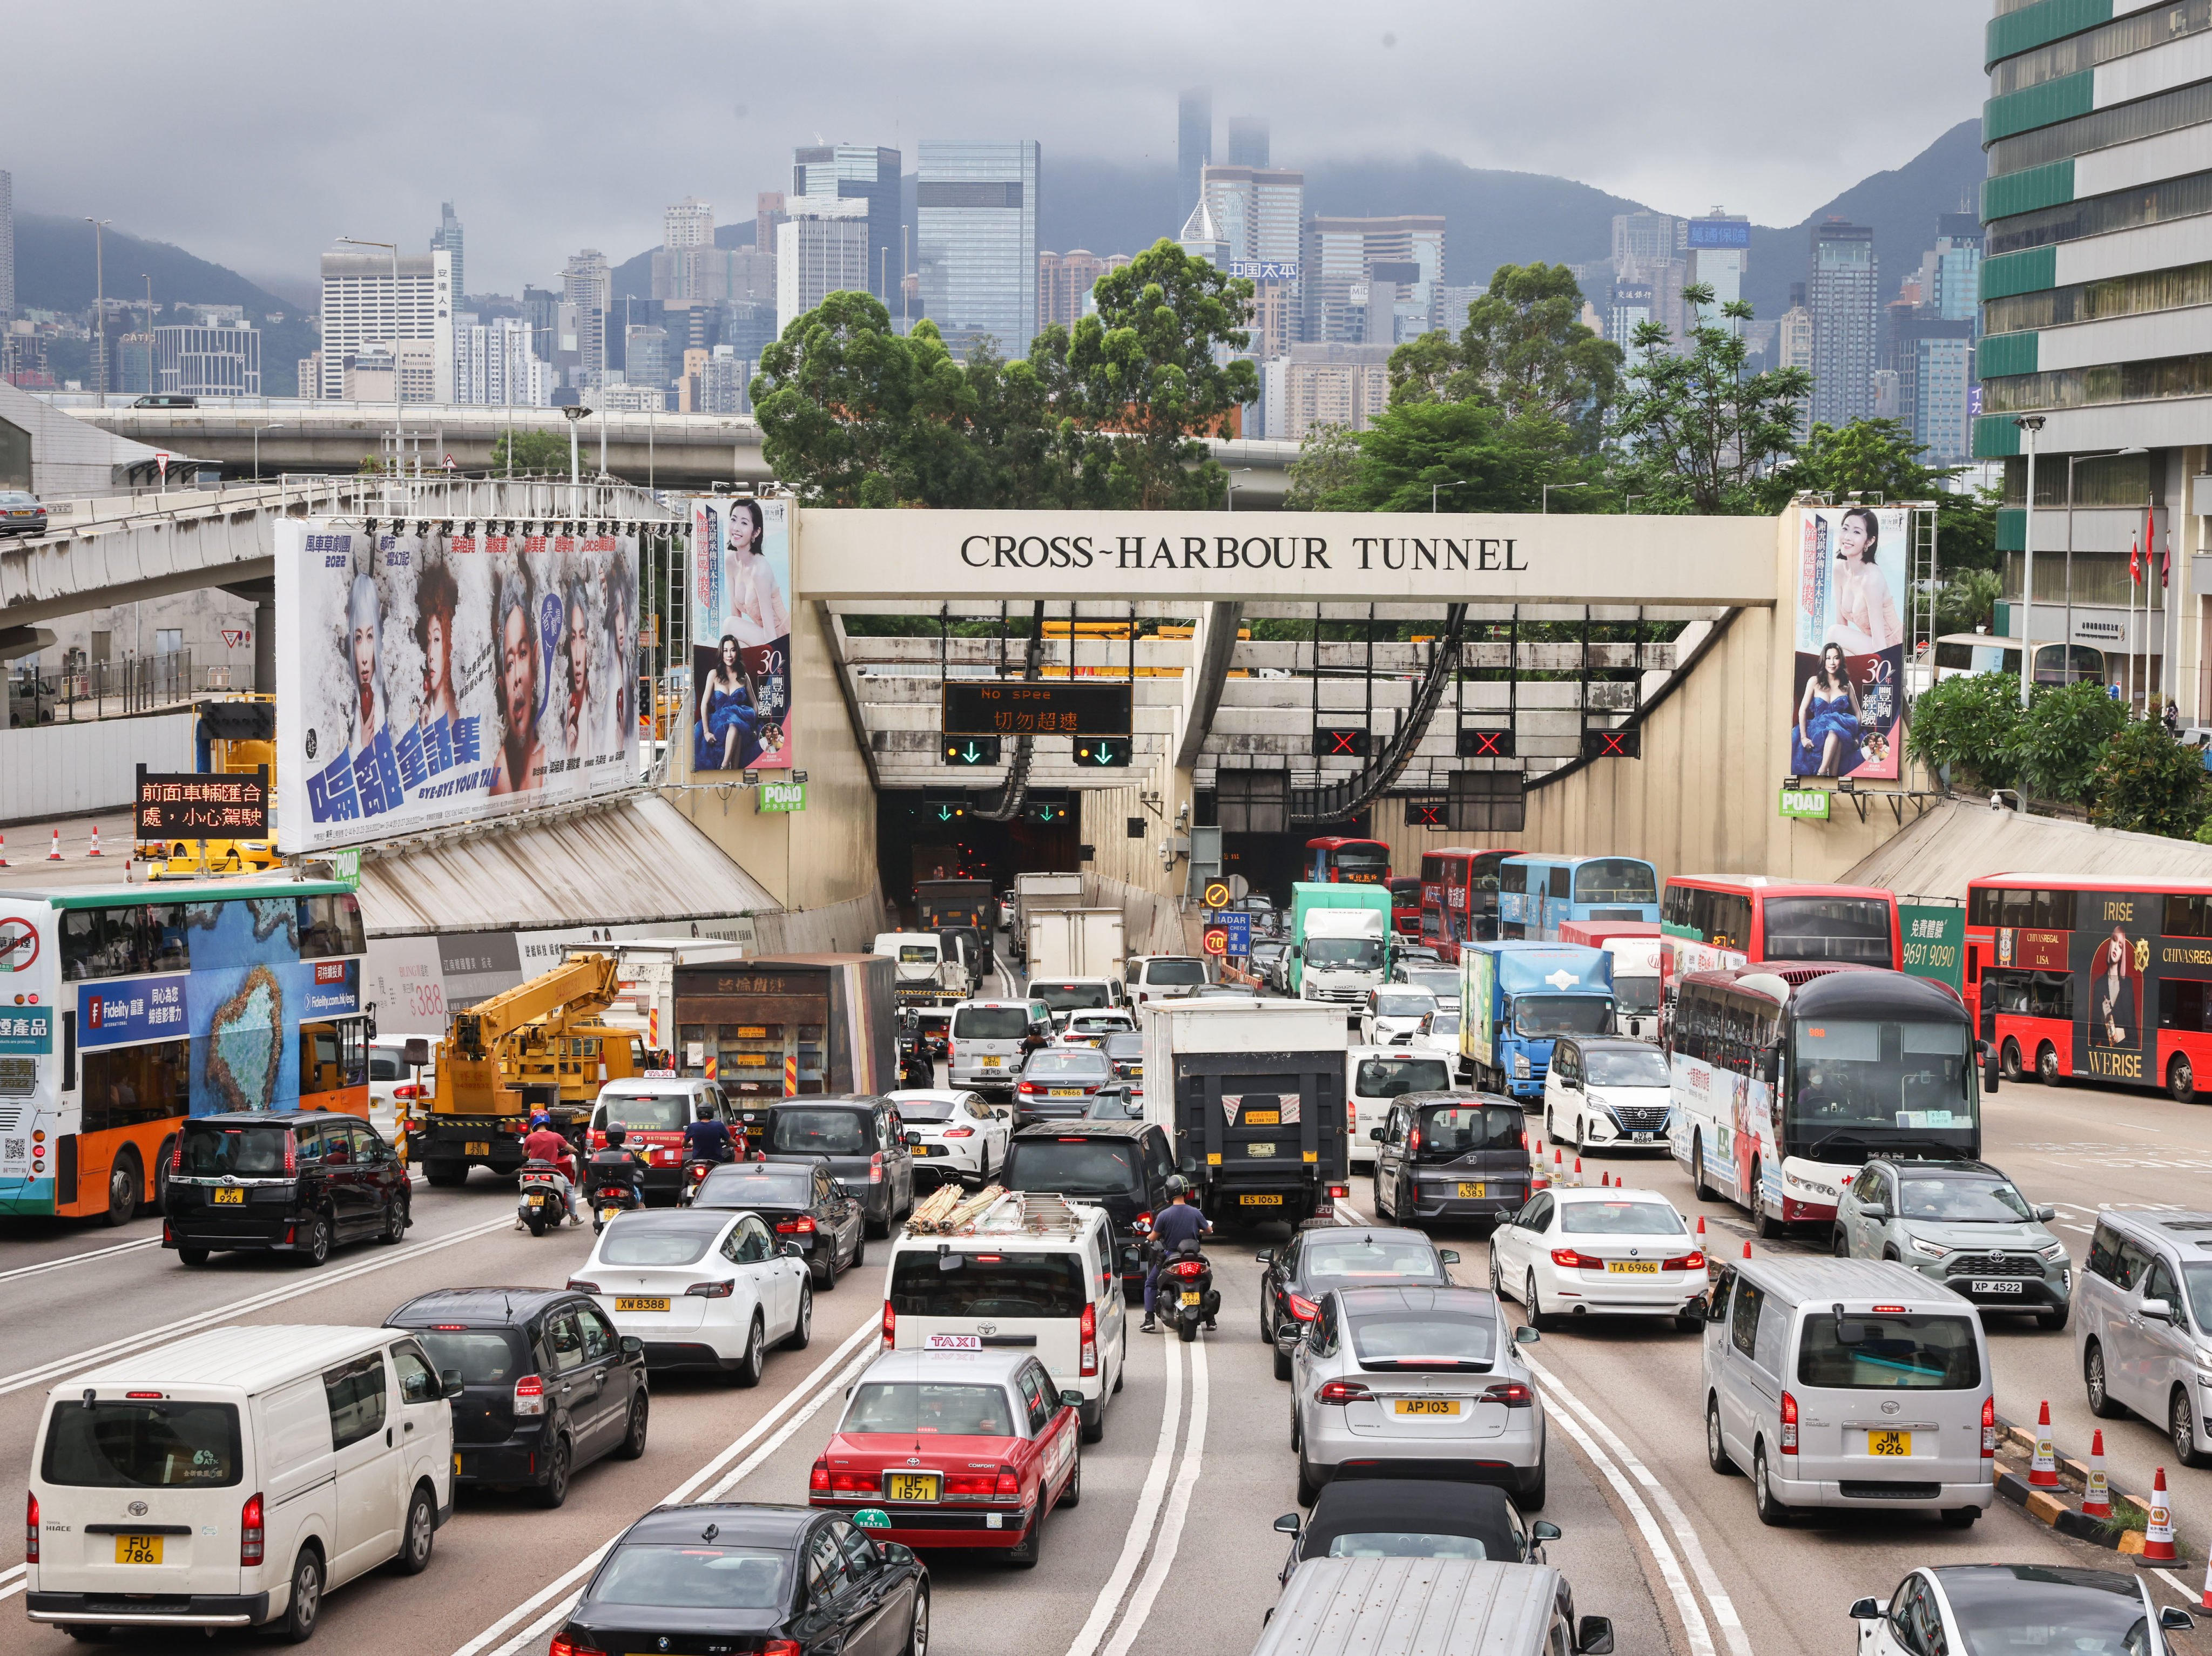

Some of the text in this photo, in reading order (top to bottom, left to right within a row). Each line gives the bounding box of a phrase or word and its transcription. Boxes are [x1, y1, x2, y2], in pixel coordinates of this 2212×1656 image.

[1692, 227, 1746, 242] 萬通保險
[1230, 262, 1296, 278] 中国太平
[438, 269, 447, 318] 安達人壽
[1617, 290, 1652, 299] 交通銀行
[305, 535, 352, 553] 風車草劇團
[380, 536, 396, 550] 都市
[485, 536, 508, 553] 湯駿業
[554, 536, 574, 552] 趙學而
[325, 556, 346, 567] 2022
[386, 551, 410, 566] 魔幻記
[697, 518, 709, 604] 幹細胞豐胸技術
[961, 535, 1528, 571] CROSS-HARBOUR TUNNEL
[1803, 529, 1816, 612] 幹細胞豐胸技術
[757, 650, 784, 675] 30
[1862, 658, 1892, 685] 30
[759, 685, 771, 716] 經驗
[771, 677, 784, 708] 豐胸
[981, 688, 1050, 699] No spee
[1862, 694, 1877, 725] 經驗
[1877, 686, 1892, 718] 豐胸
[994, 711, 1078, 731] 切勿超速
[306, 710, 481, 823] 隔離童話集
[418, 766, 502, 799] BYE-BYE YOUR TALE
[142, 783, 262, 802] 前面車輛匯合
[765, 786, 801, 803] POAD
[1783, 793, 1825, 811] POAD
[142, 807, 262, 827] 處，小心駕駛
[337, 851, 358, 878] POAD
[1209, 937, 1223, 948] 70
[1903, 942, 1955, 968] 9691 9090
[2036, 955, 2049, 965] LISA
[317, 964, 343, 981] 可持續投資
[152, 986, 179, 1005] 同心為您
[312, 994, 355, 1010] Fidelity.com.hk/esg
[103, 999, 129, 1019] Fidelity
[130, 998, 144, 1016] 富達
[148, 1005, 182, 1025] 締造影響力
[1809, 1028, 1825, 1037] 988
[1867, 1152, 1905, 1160] MAN
[220, 1195, 238, 1203] 926
[1628, 1263, 1655, 1272] 6966
[1975, 1283, 2020, 1292] XP 4522
[621, 1300, 665, 1309] XW 8388
[931, 1336, 975, 1347] TAXI
[1406, 1403, 1450, 1412] AP 103
[1881, 1432, 1899, 1443] JM
[1876, 1444, 1904, 1455] 926
[898, 1488, 928, 1499] 1671
[867, 1513, 875, 1522] 4
[129, 1537, 150, 1549] FU
[124, 1549, 154, 1563] 786
